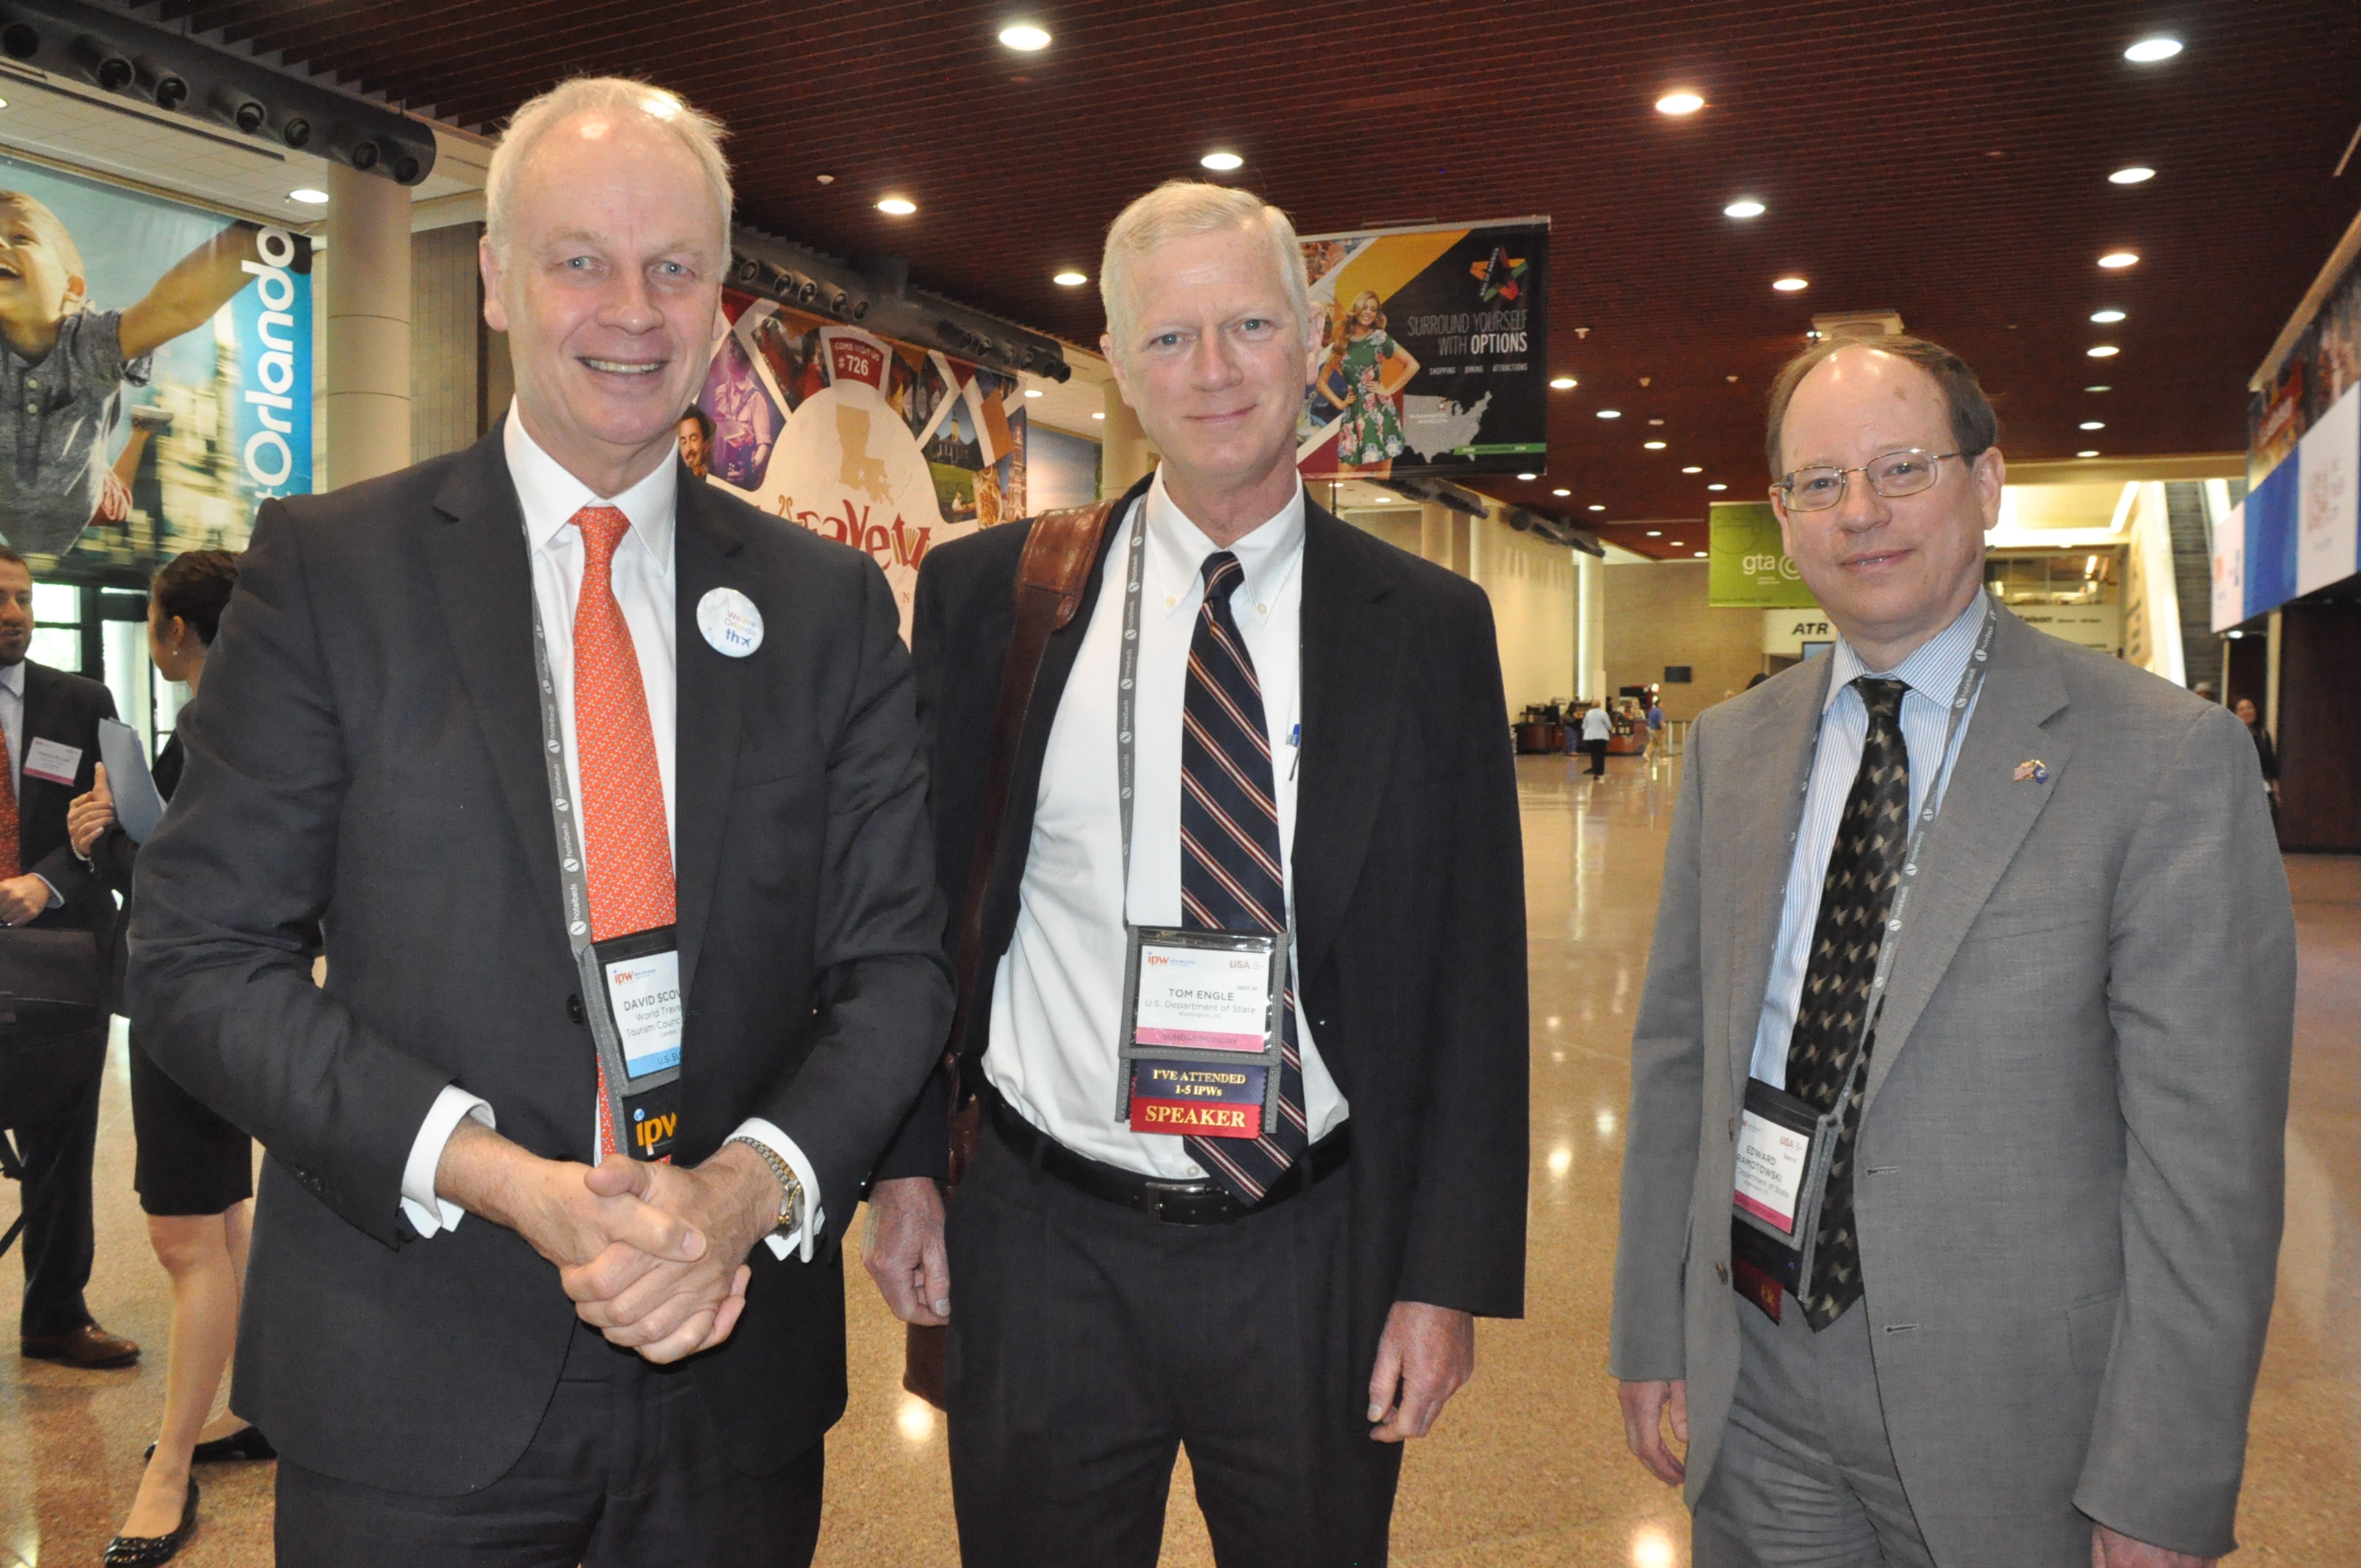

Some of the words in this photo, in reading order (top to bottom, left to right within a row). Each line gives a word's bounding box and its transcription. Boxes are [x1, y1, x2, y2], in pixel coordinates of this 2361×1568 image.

[1407, 313, 1469, 336] SURROUND
[1473, 309, 1528, 333] YOURSELF
[835, 342, 854, 351] COME
[854, 344, 870, 356] VISIT
[871, 351, 880, 361] US
[1438, 335, 1468, 356] WITH
[1470, 332, 1528, 355] OPTIONS
[242, 225, 294, 487] Orlando
[1742, 553, 1775, 576] gta
[728, 611, 741, 622] We
[724, 617, 757, 636] Orlando
[553, 763, 563, 797] hotelbeds
[562, 822, 573, 857] hotelbeds
[1910, 831, 1925, 863] hotelbeds
[570, 883, 581, 921] hotelbeds
[1895, 886, 1910, 919] hotelbeds
[1230, 960, 1250, 970] USA
[623, 995, 656, 1011] DAVID
[1169, 989, 1193, 998] TOM
[1197, 990, 1235, 1001] ENGLE
[635, 1008, 659, 1021] World
[1145, 1000, 1161, 1008] U.S.
[1165, 1001, 1218, 1012] Department
[1221, 1004, 1230, 1012] of
[1233, 1005, 1255, 1014] State
[625, 1025, 656, 1037] Tourism
[1163, 1034, 1238, 1045] SUNDAY/MONDAY
[1153, 1069, 1178, 1081] I'VE
[1180, 1072, 1246, 1085] ATTENDED
[1175, 1085, 1191, 1095] 1-5
[1193, 1086, 1222, 1097] IPWs
[1145, 1106, 1246, 1128] SPEAKER
[1746, 1145, 1776, 1166] EDWARD
